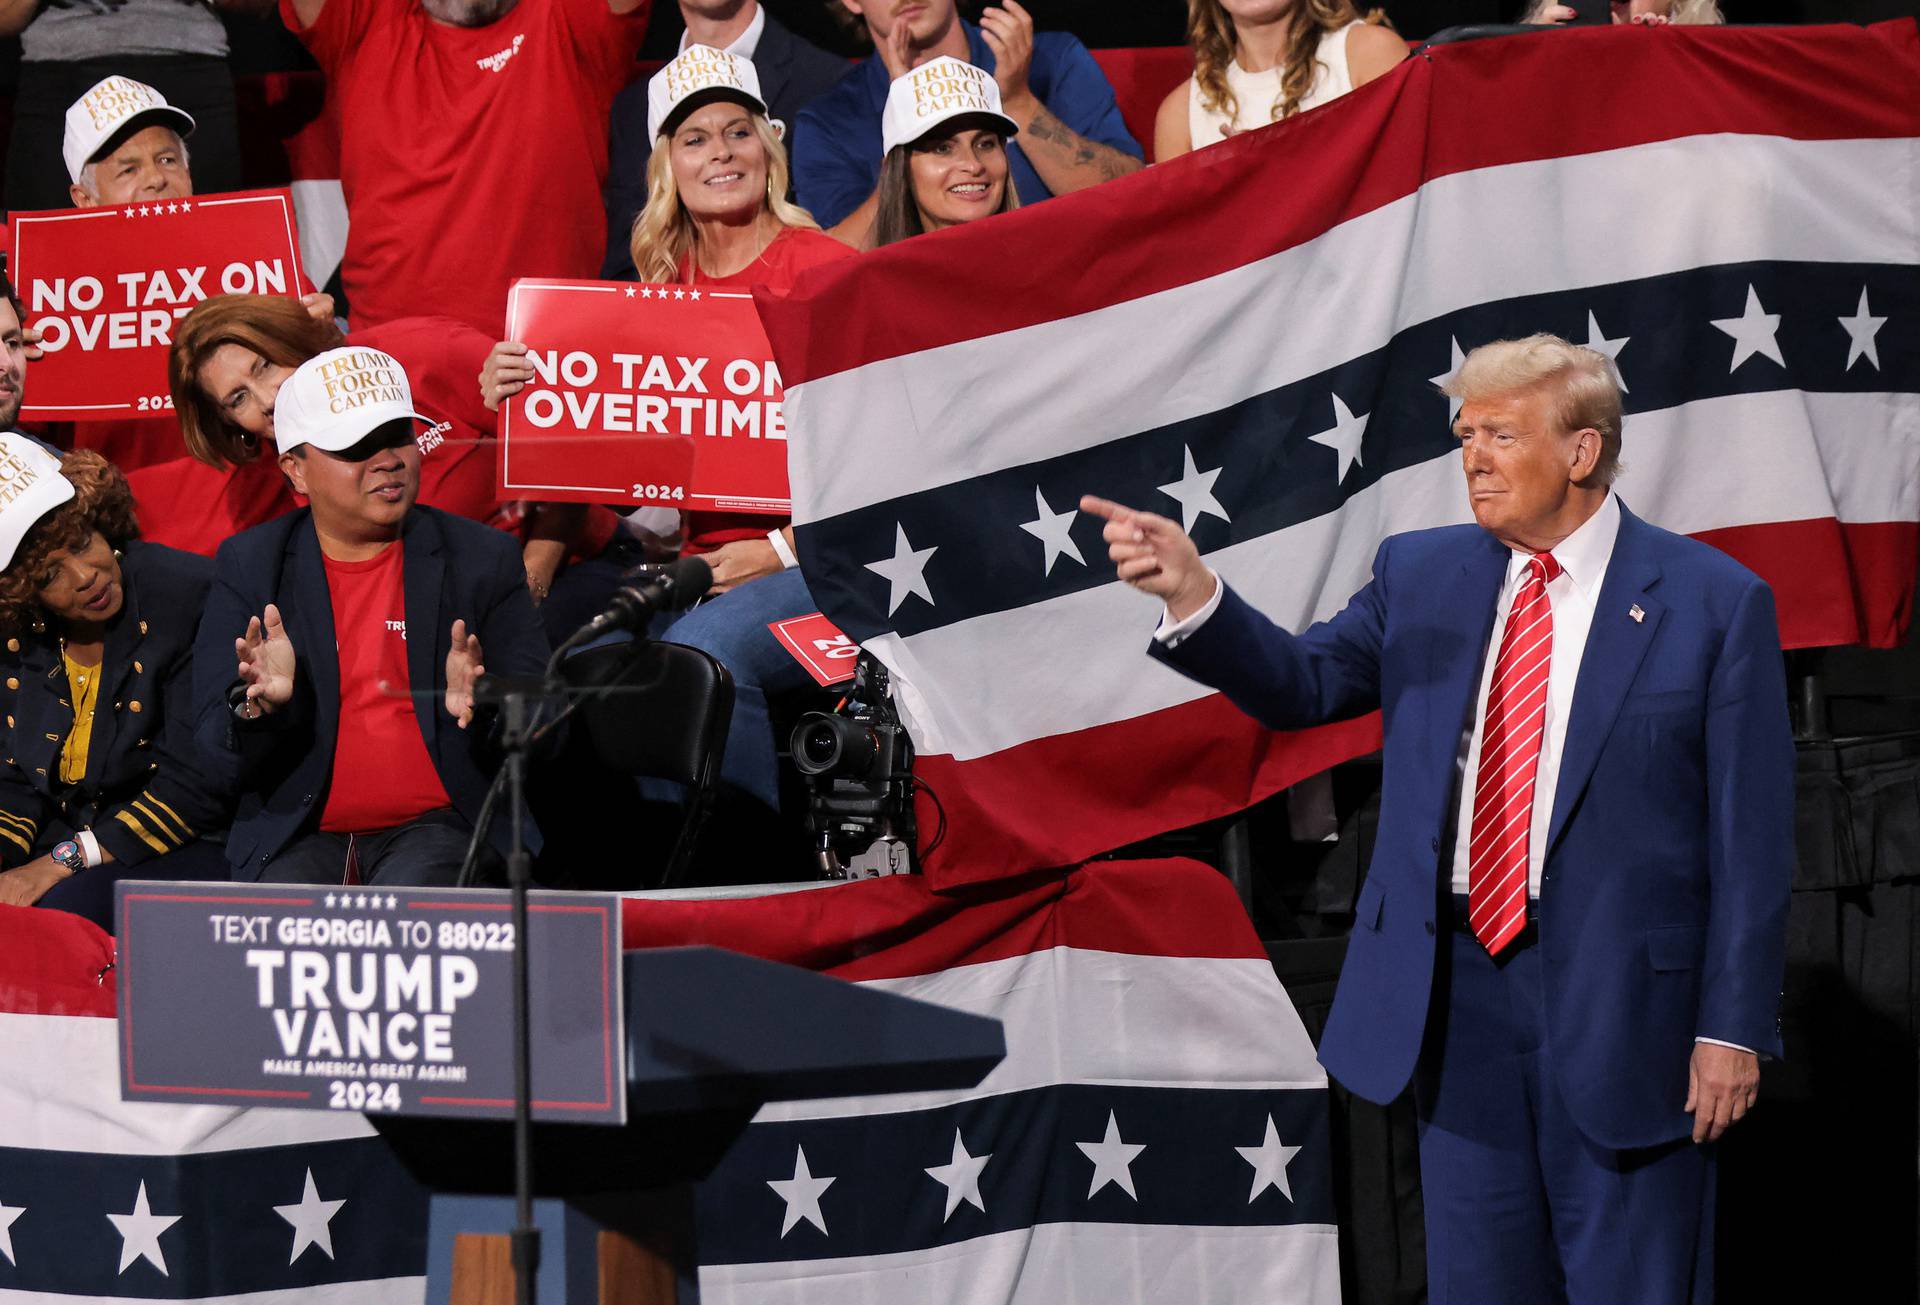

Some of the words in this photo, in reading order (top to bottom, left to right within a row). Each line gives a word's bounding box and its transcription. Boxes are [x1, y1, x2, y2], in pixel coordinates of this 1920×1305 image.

[667, 61, 740, 89] FORCE
[669, 74, 743, 101] CAPTAIN
[908, 63, 985, 86] TRUMP
[914, 79, 987, 102] FORCE
[916, 95, 990, 117] CAPTAIN
[32, 276, 104, 312] NO
[117, 266, 208, 308] TAX
[221, 258, 287, 296] ON
[32, 307, 195, 352] OVER
[316, 352, 390, 381] TRUMP
[525, 349, 599, 387] NO
[612, 353, 709, 393] TAX
[324, 370, 400, 400] FORCE
[137, 395, 176, 411] 202
[330, 387, 405, 414] CAPTAIN
[524, 389, 787, 440] OVERTIME
[417, 421, 452, 447] FORCE
[419, 434, 445, 456] TAIN
[632, 484, 684, 500] 2024
[210, 915, 272, 943] TEXT
[277, 917, 392, 946] GEORGIA
[398, 920, 432, 948] TO
[437, 922, 516, 951] 88022
[246, 949, 479, 1013] TRUMP
[273, 1009, 454, 1062] VANCE
[263, 1058, 302, 1075] MAKE
[305, 1061, 367, 1079] AMERICA
[370, 1062, 414, 1080] GREAT
[417, 1064, 467, 1083] AGAIN!
[329, 1080, 402, 1111] 2024
